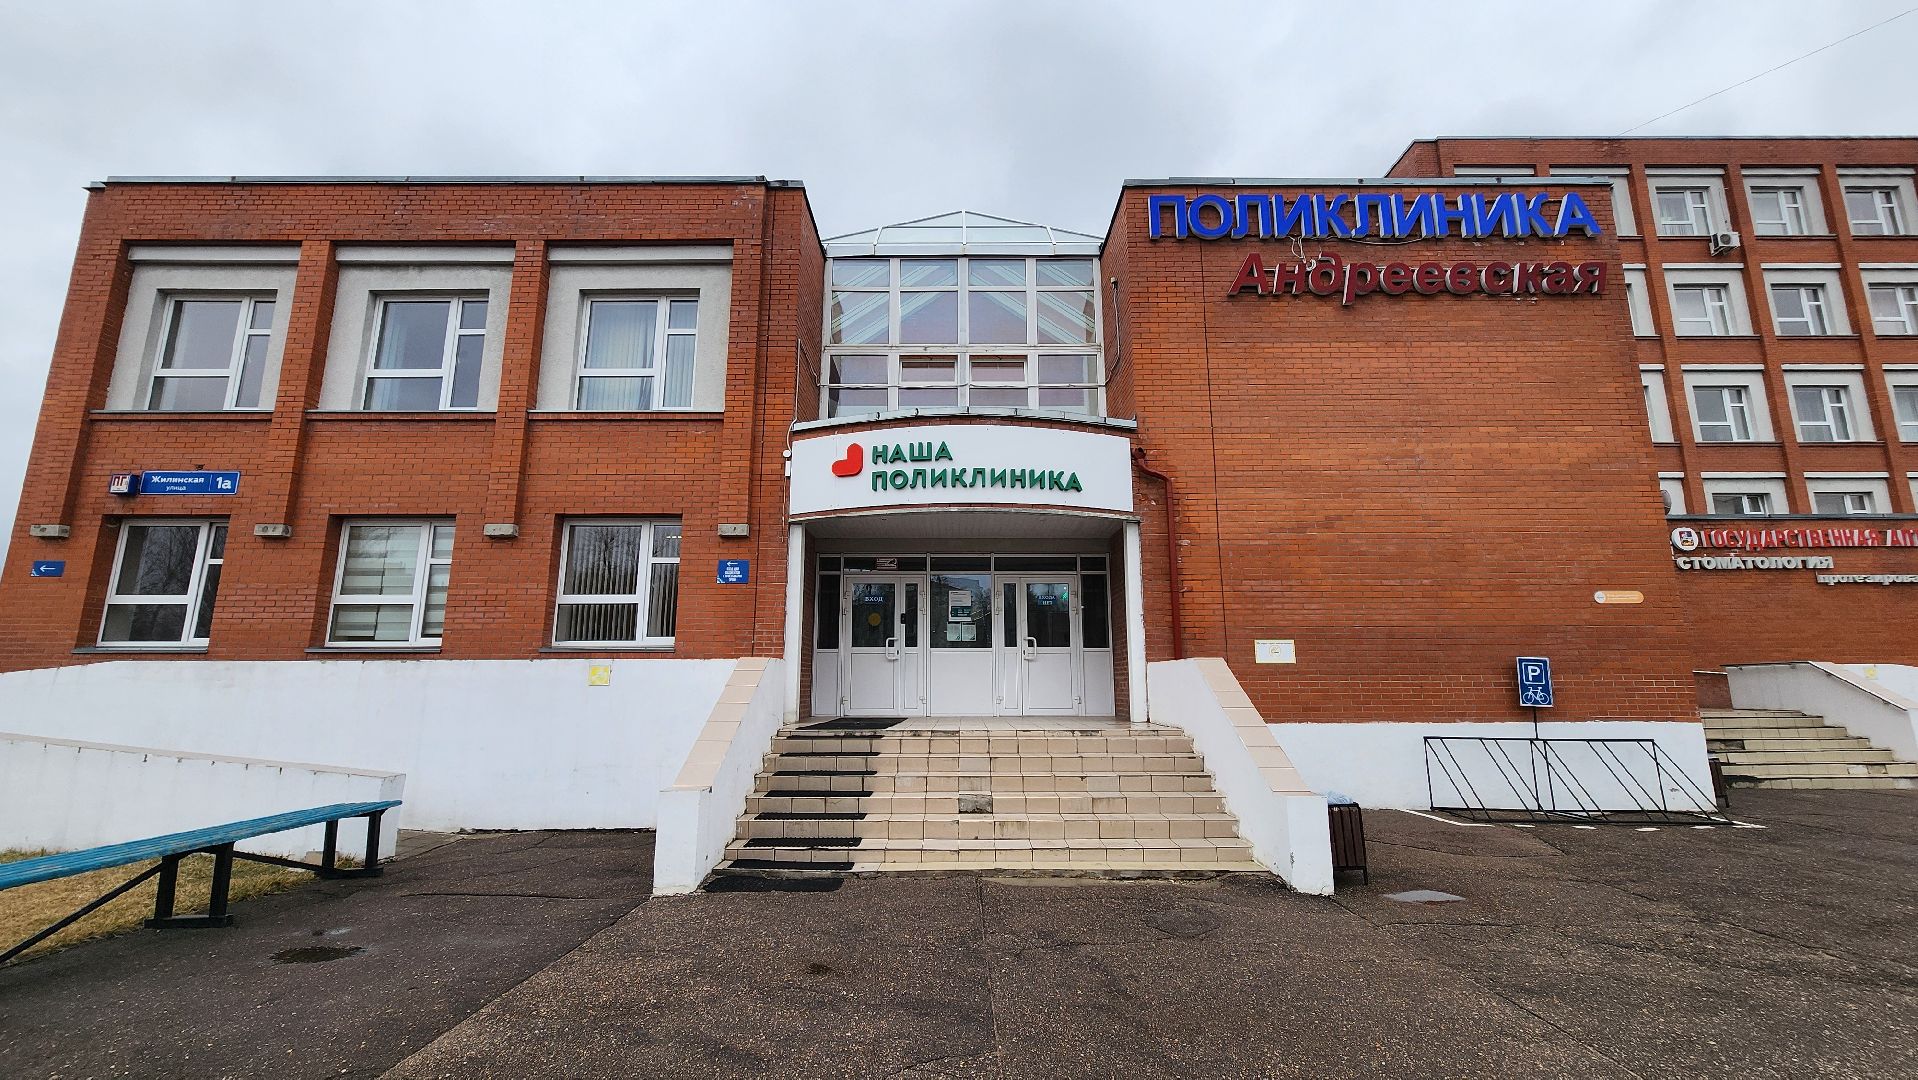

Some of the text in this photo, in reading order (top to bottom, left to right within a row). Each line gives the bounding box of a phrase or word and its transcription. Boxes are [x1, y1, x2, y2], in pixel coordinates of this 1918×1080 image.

[1148, 192, 1604, 240] ПОЛИКЛИНИКА
[1227, 250, 1608, 306] Андреевская
[871, 441, 953, 465] НАША
[151, 475, 232, 490] Жилинская 1а
[871, 468, 1083, 492] ПОЛИКЛИНИКА
[1701, 528, 1879, 551] ГОСУДАРСТВЕННАЯ
[1676, 556, 1834, 570] СТОМАТОЛОГИЯ
[1527, 665, 1541, 682] P
